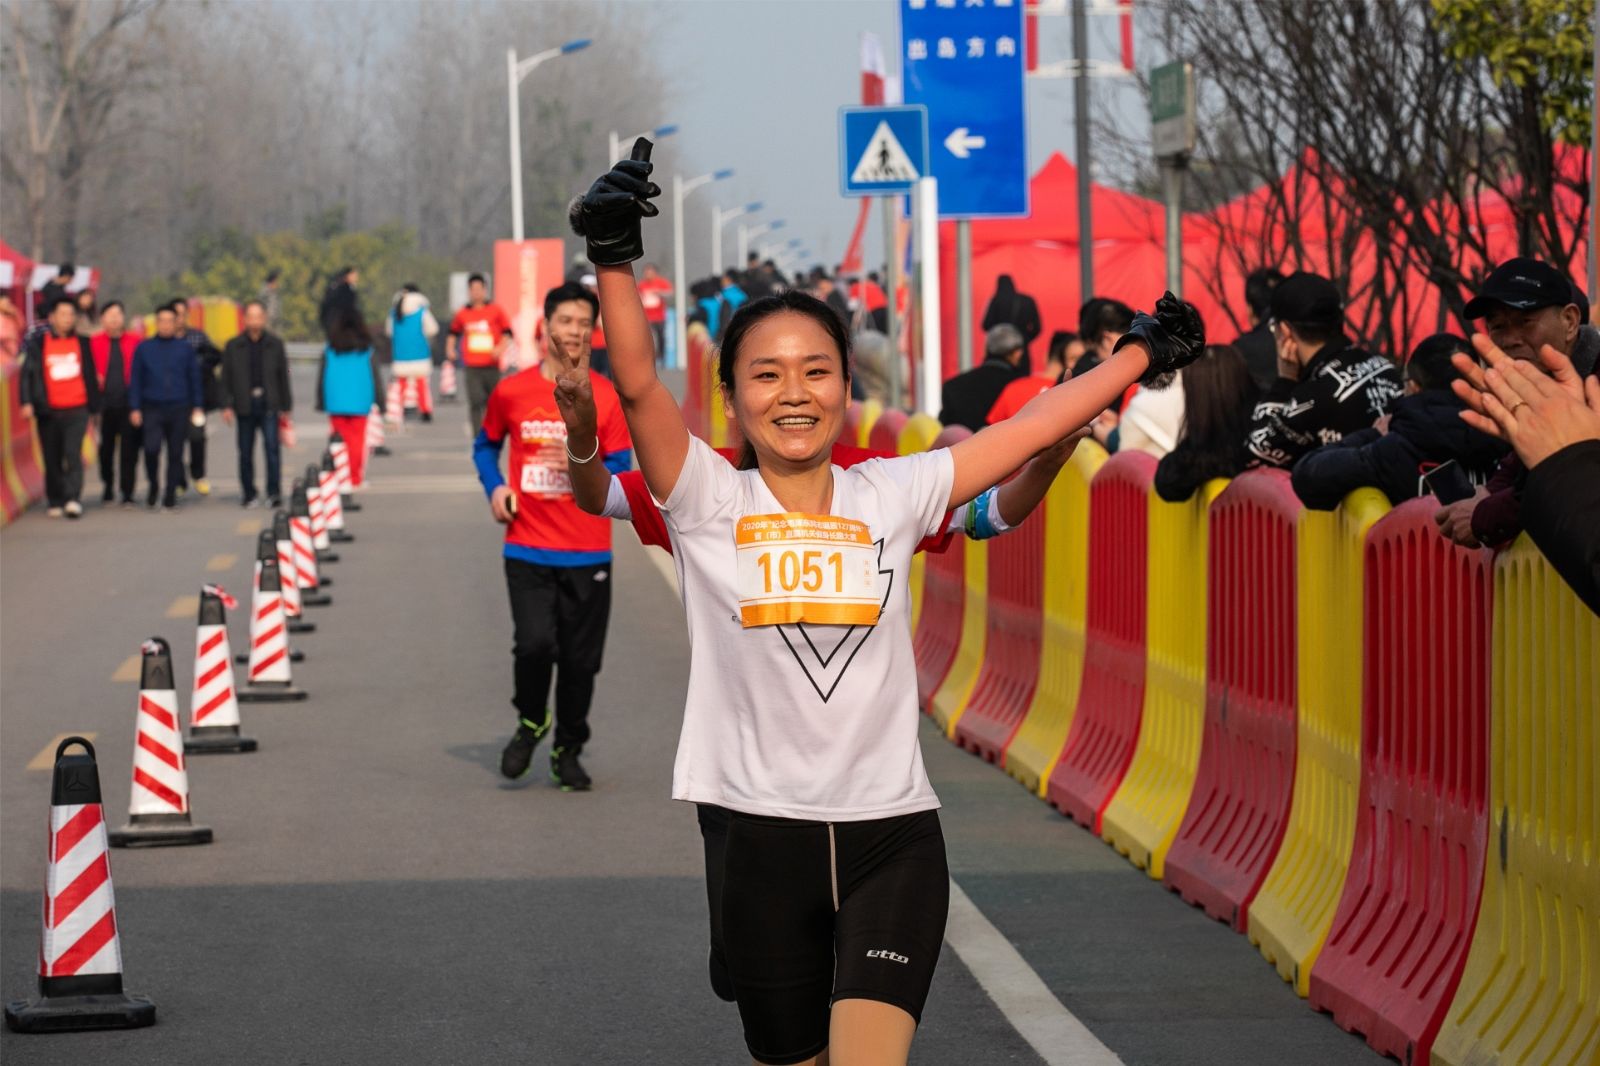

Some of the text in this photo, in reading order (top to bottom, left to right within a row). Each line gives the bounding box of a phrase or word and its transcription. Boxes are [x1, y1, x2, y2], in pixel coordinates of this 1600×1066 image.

[908, 36, 1016, 60] 出岛方向
[526, 469, 572, 489] A105
[757, 550, 843, 593] 1051
[866, 949, 909, 964] etto
